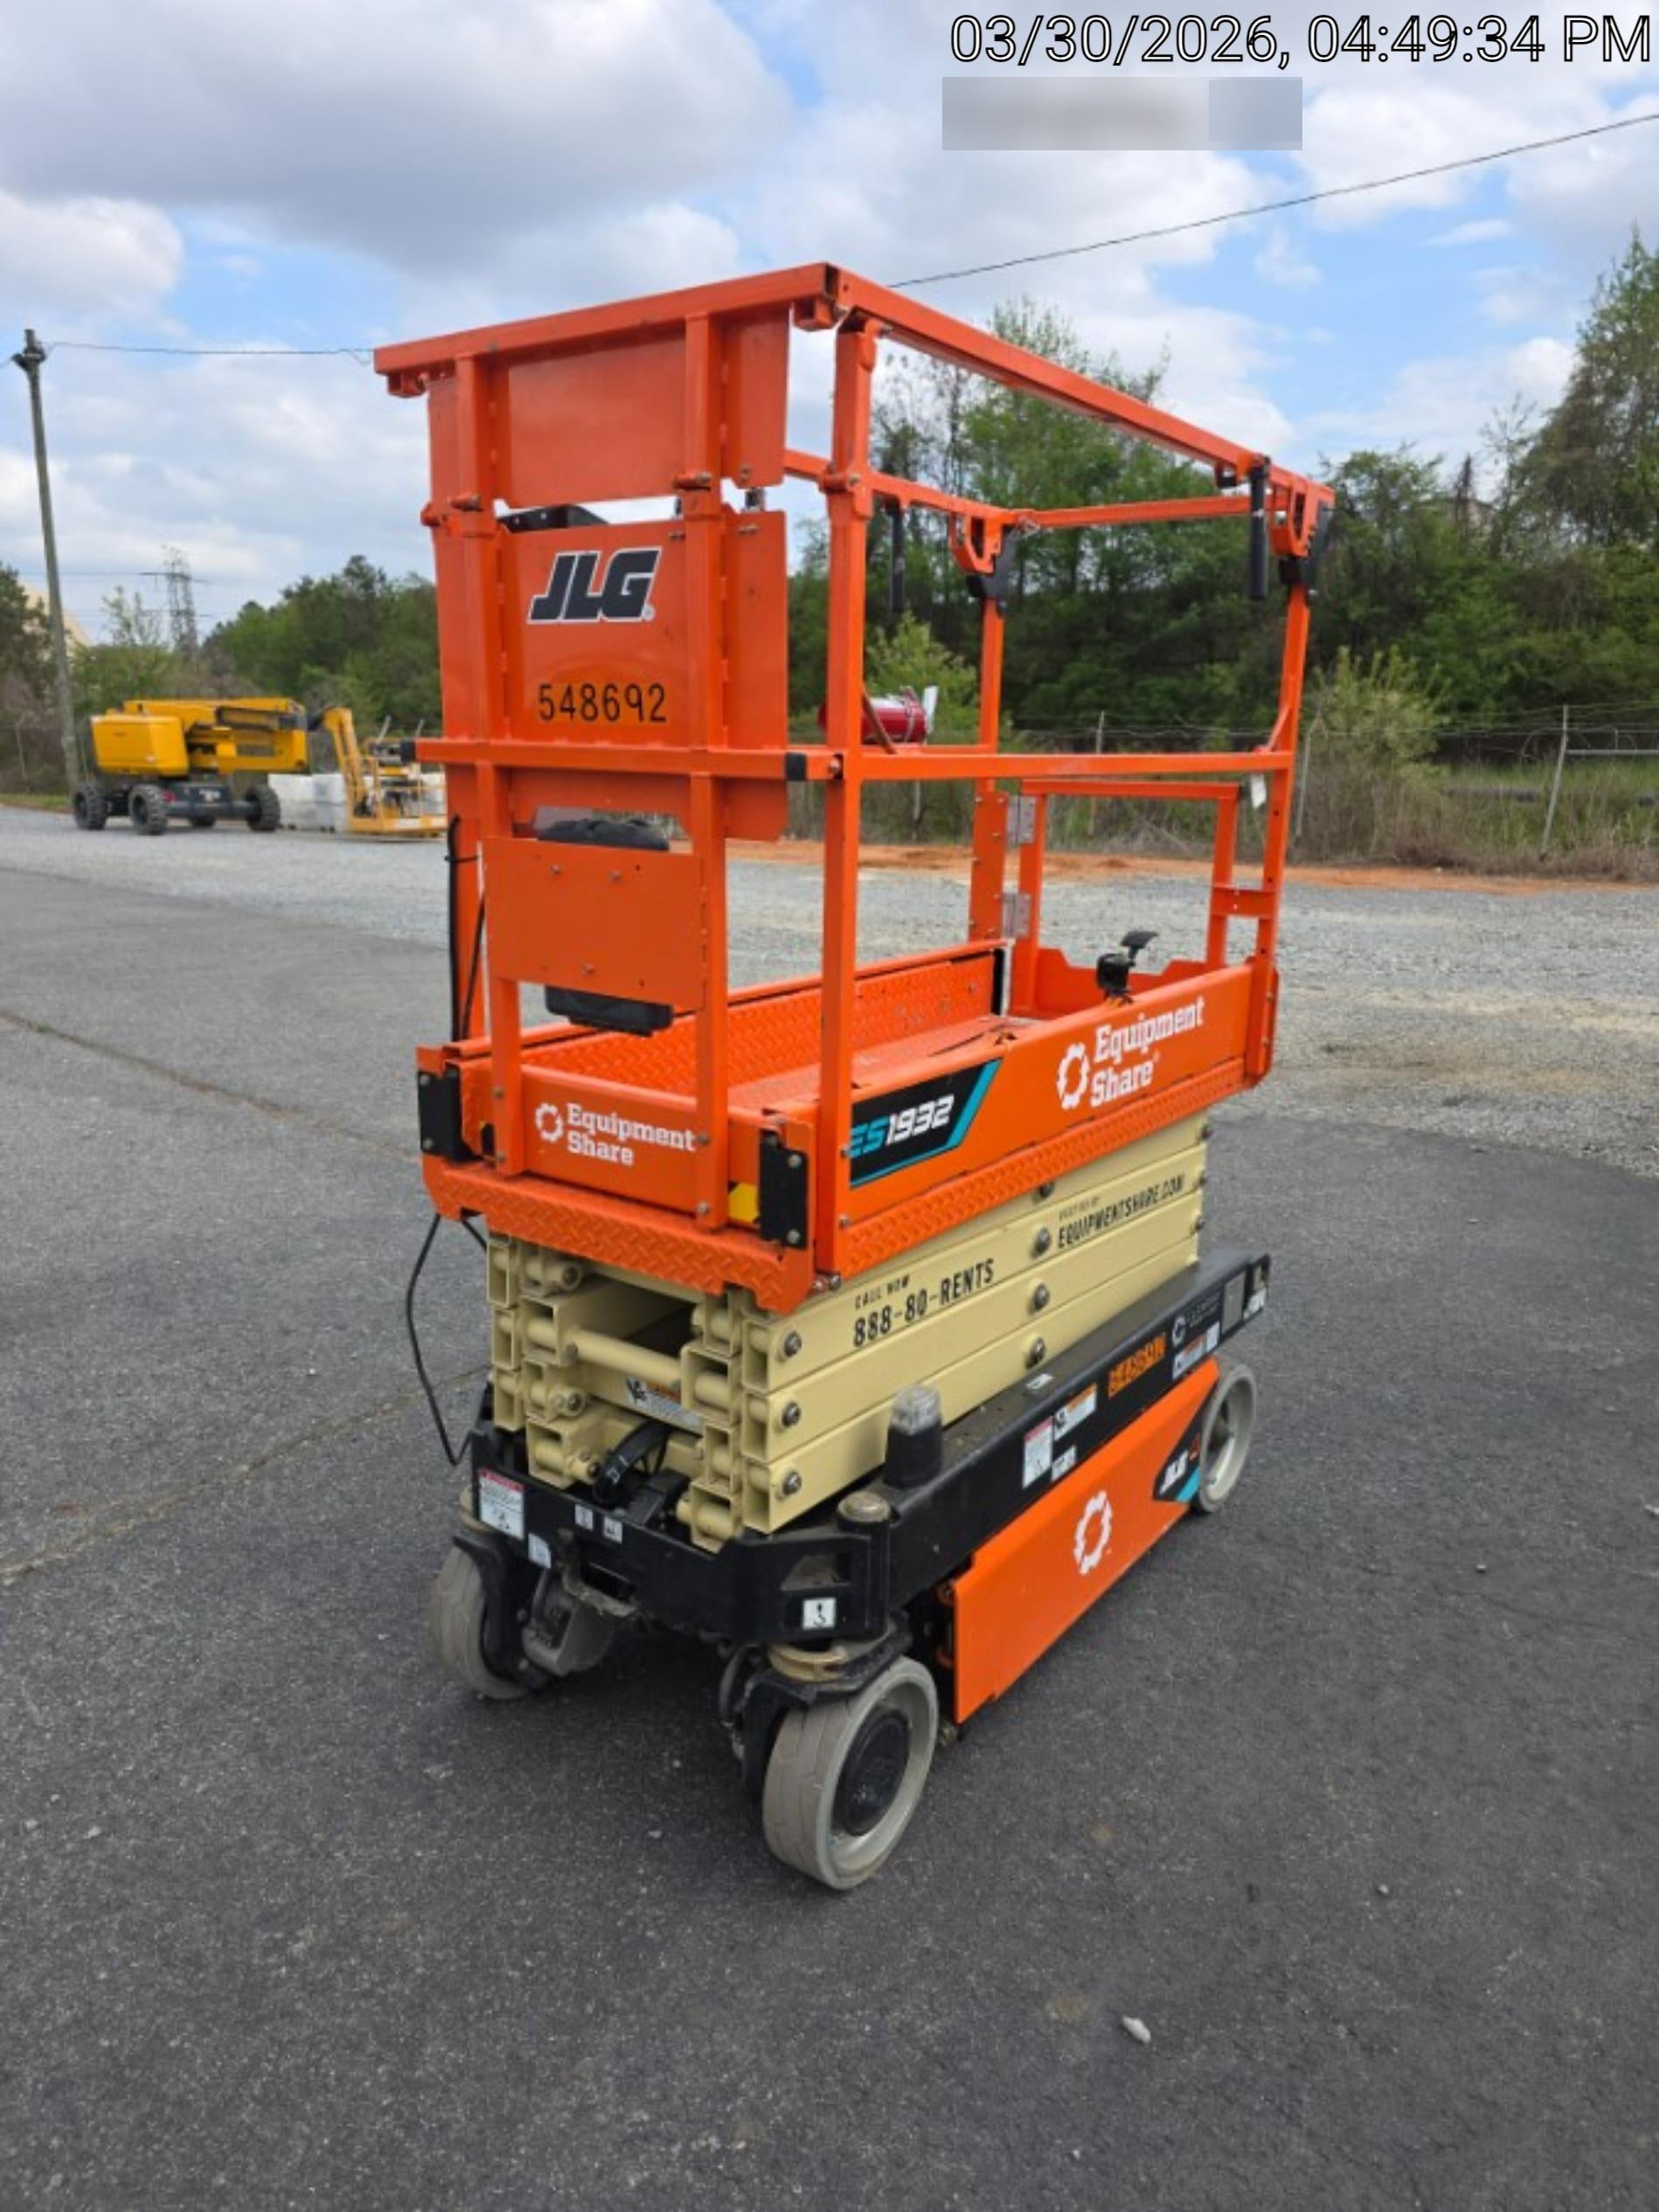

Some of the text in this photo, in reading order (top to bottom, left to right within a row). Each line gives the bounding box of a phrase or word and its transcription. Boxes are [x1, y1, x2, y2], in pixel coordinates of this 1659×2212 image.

[527, 545, 663, 624] JLG
[538, 682, 667, 724] 548692
[1094, 995, 1205, 1064] Equipment
[1091, 1064, 1155, 1107] Share
[566, 1102, 697, 1152] Equipment
[567, 1130, 635, 1167] Share
[850, 1093, 954, 1158] ES1932
[854, 1258, 995, 1348] 888-80-RENTS
